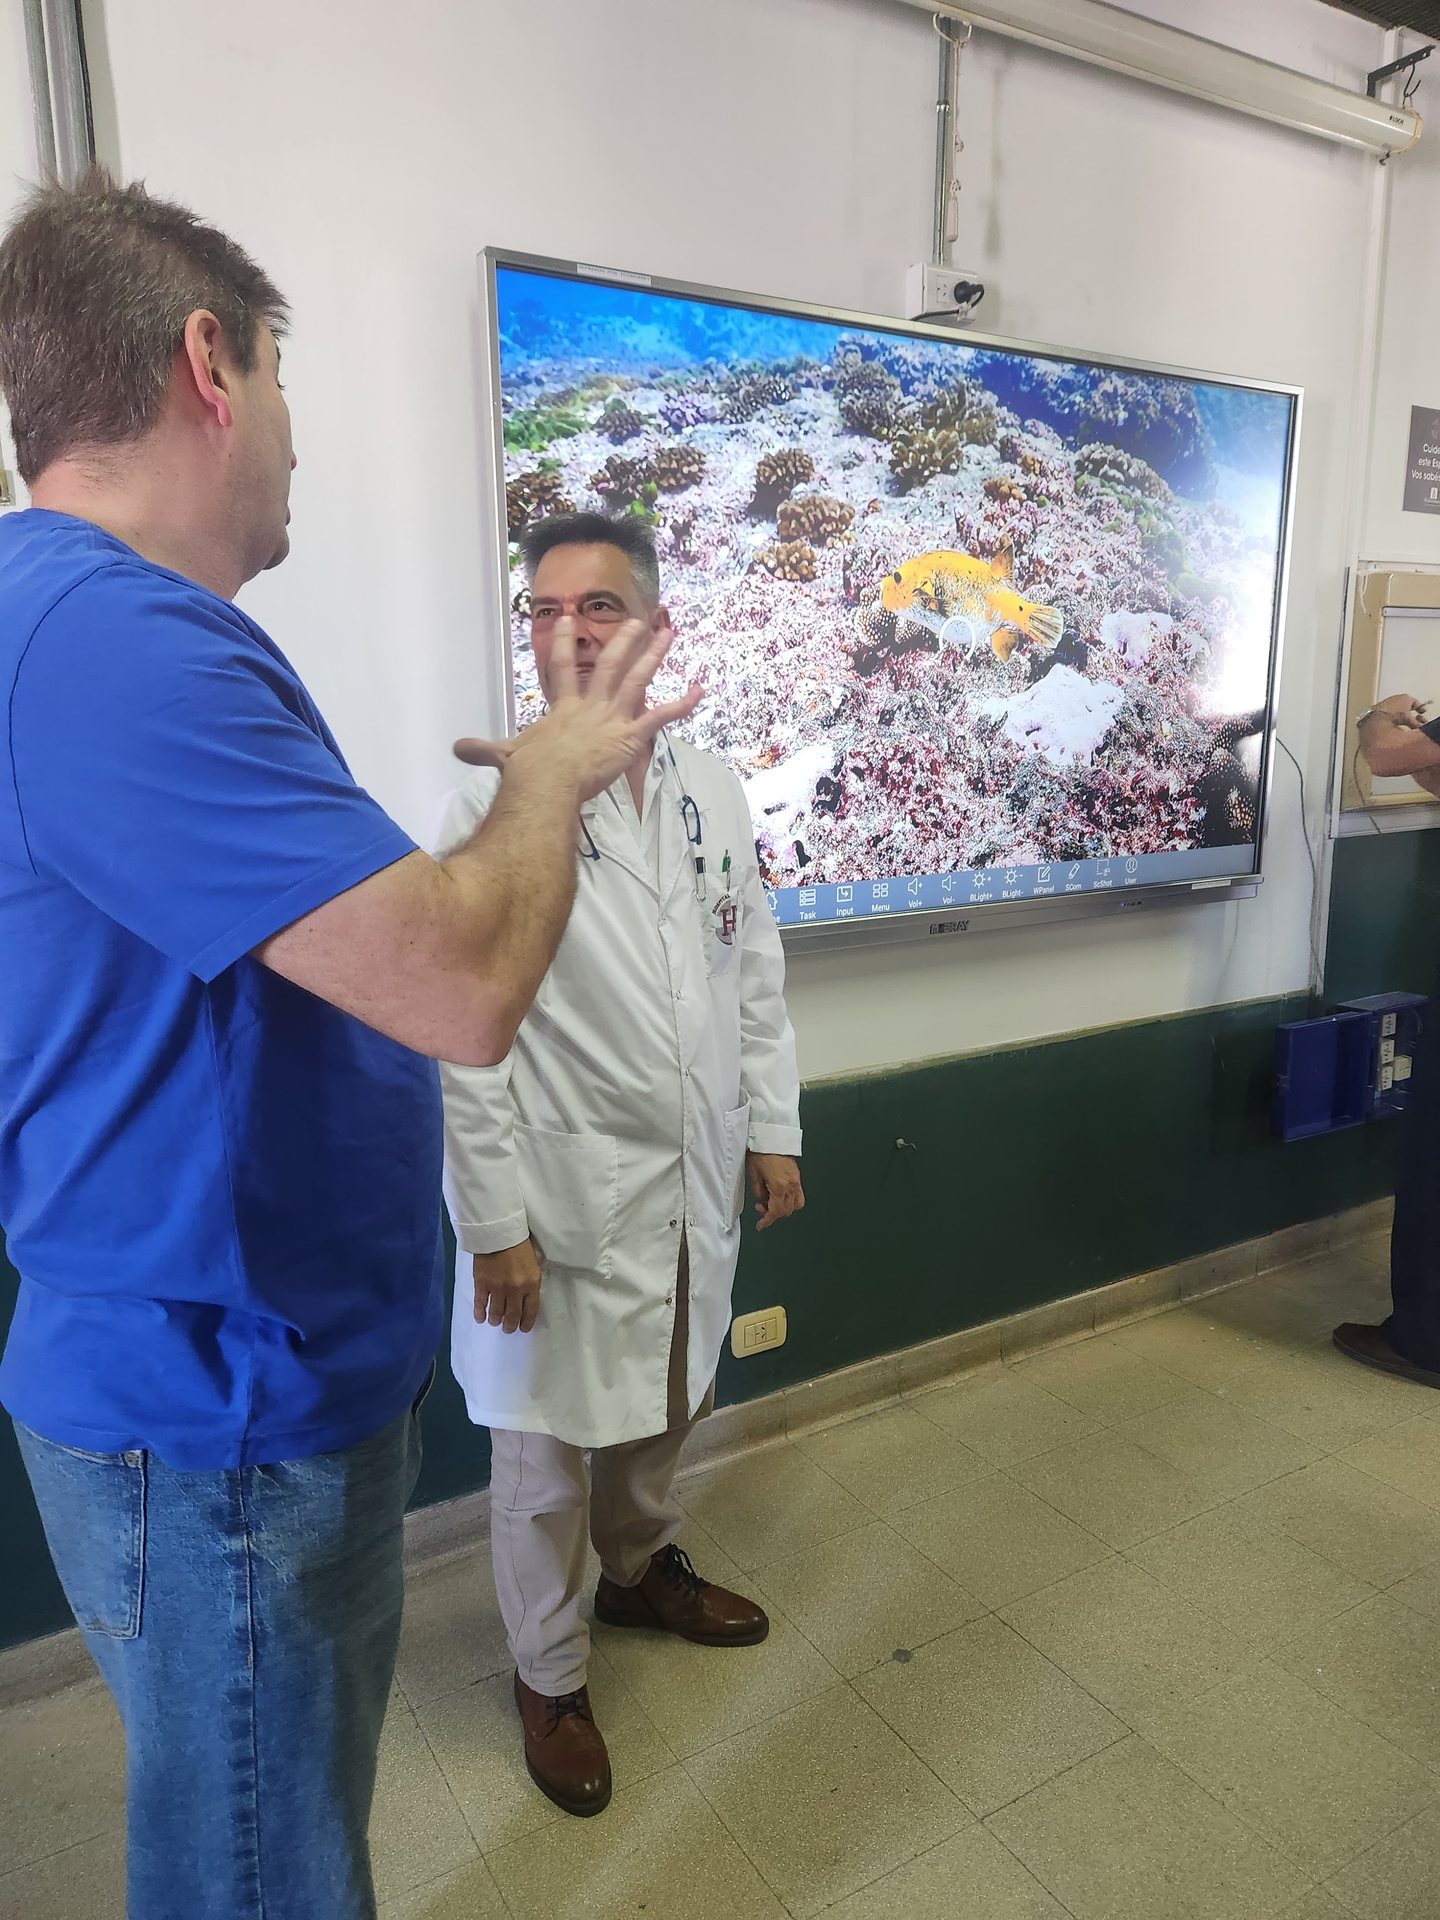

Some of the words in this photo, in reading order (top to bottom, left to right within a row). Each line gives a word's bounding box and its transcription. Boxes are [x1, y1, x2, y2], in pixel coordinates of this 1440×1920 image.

[1418, 458, 1431, 467] este
[1411, 469, 1422, 479] Vos
[1093, 879, 1113, 888] ScShot
[1124, 877, 1137, 885] User
[1033, 885, 1055, 895] WPanel
[1065, 883, 1082, 891] SCom
[970, 893, 993, 902] BLight+
[1002, 890, 1024, 899] BLight-
[712, 893, 731, 915] HOSPITAL
[908, 900, 923, 908] Vol+
[943, 896, 956, 904] Vol-
[836, 907, 854, 918] Input
[871, 904, 890, 912] Menu
[800, 911, 816, 920] Task
